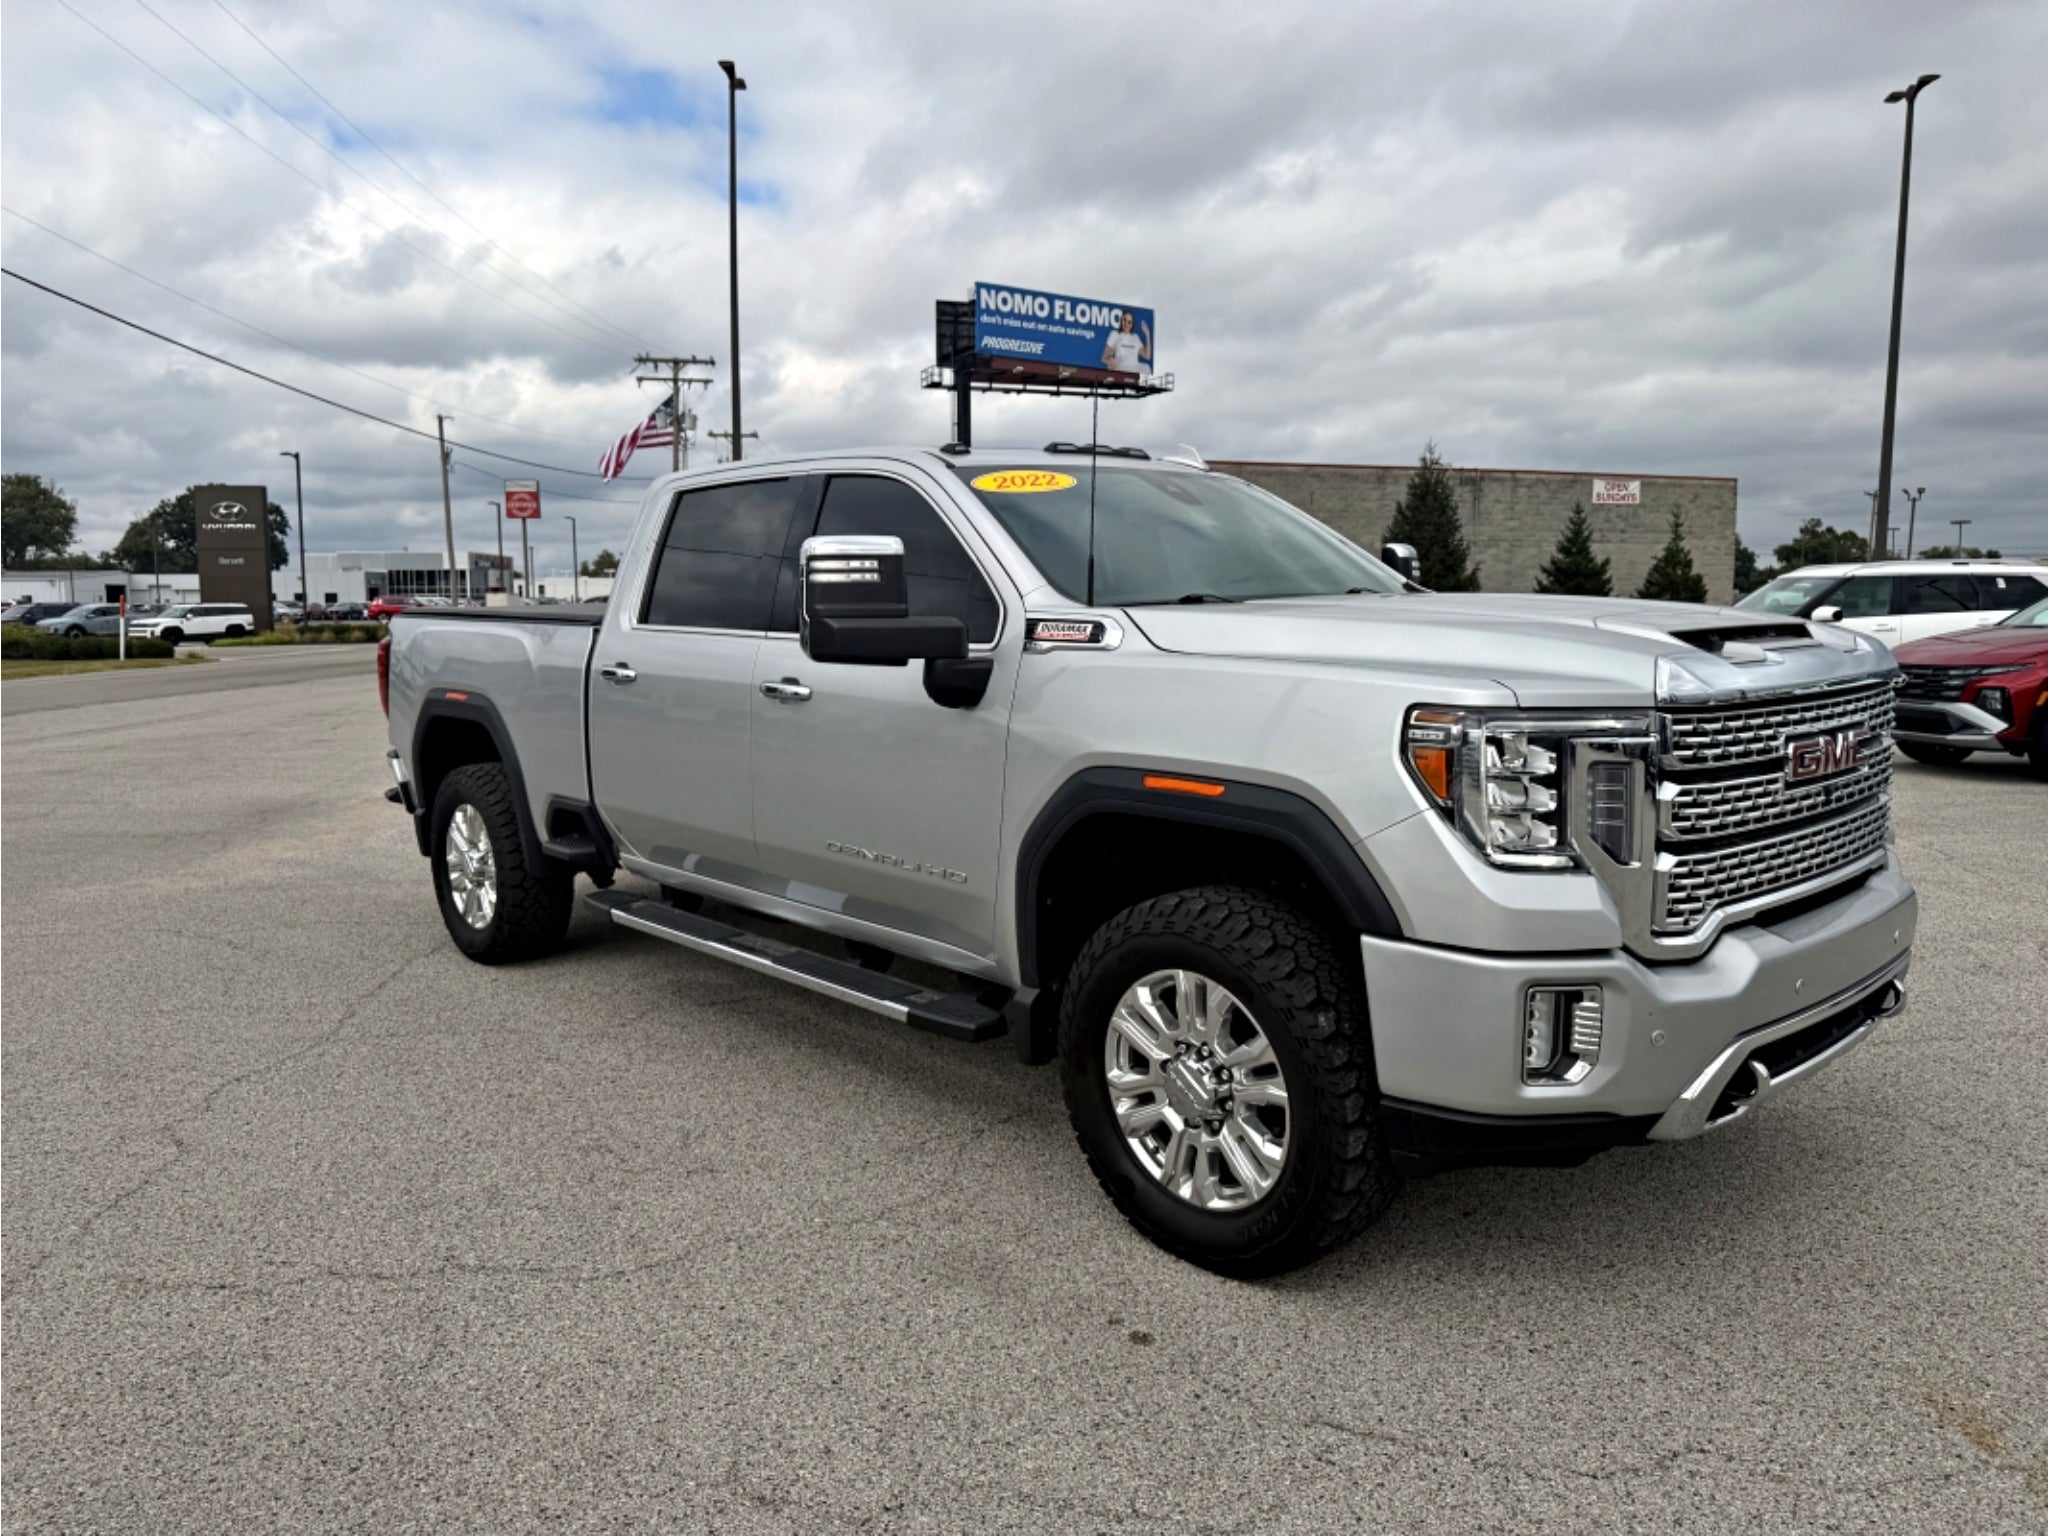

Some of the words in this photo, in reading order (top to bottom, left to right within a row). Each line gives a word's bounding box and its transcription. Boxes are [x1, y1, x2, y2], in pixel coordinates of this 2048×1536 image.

[979, 287, 1050, 318] NOMO
[1053, 299, 1123, 329] FLOMO
[979, 314, 1002, 325] don't
[1003, 317, 1022, 328] miss
[1066, 326, 1096, 340] savings
[980, 335, 1046, 354] PROGRESSIVE
[993, 474, 1059, 490] 2022
[1604, 481, 1629, 492] OPEN
[1596, 492, 1638, 502] SUNDAYS
[1787, 723, 1870, 782] GMC
